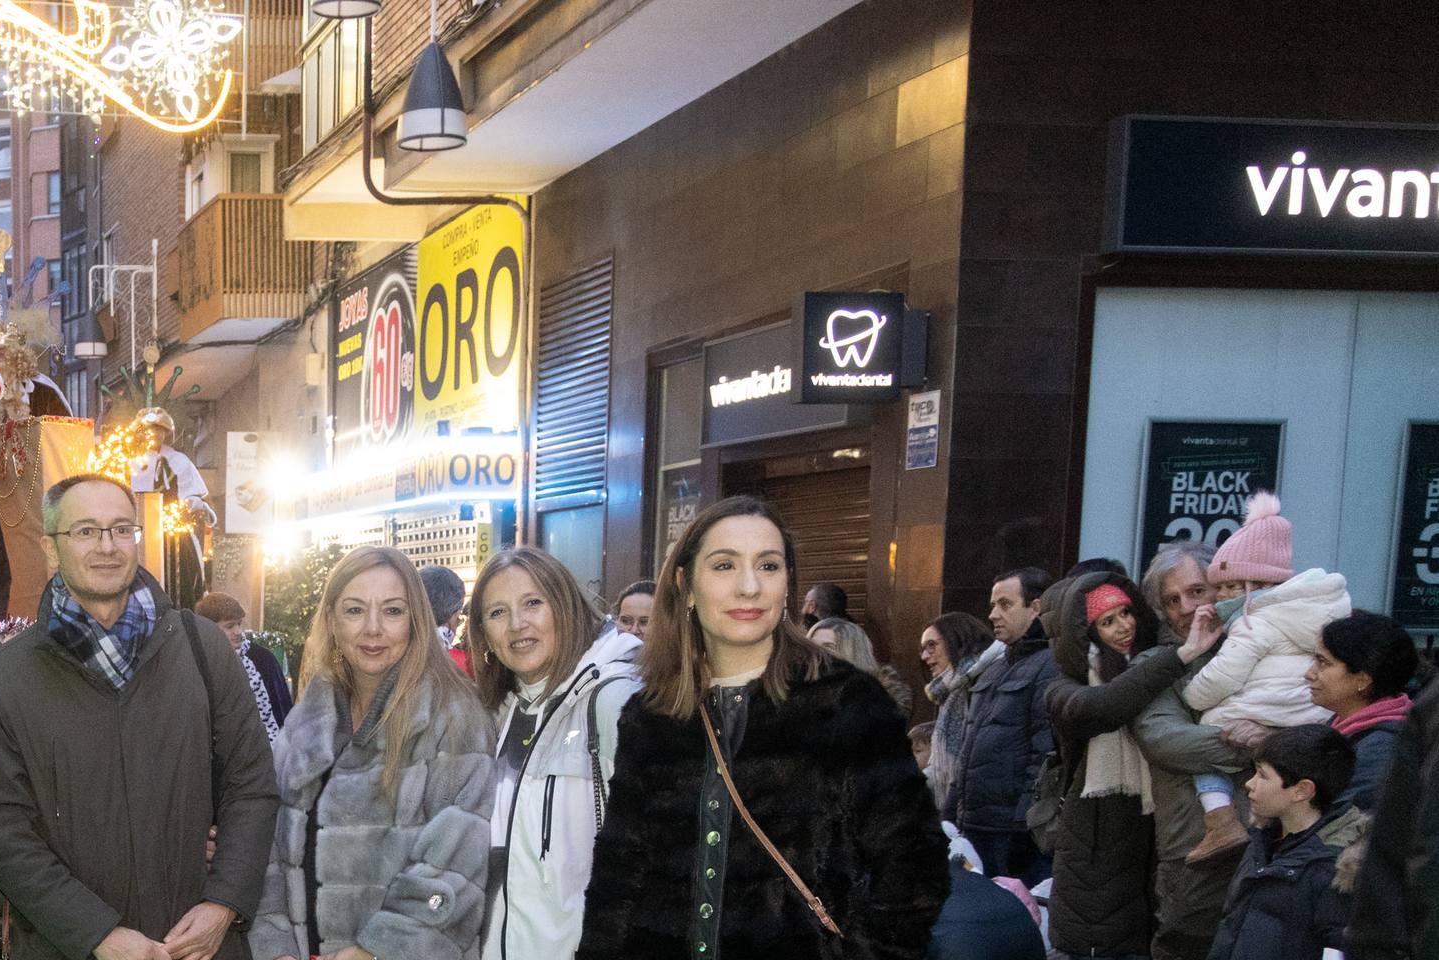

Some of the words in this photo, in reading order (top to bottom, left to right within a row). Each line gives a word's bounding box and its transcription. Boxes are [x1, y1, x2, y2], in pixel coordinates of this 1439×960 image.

[338, 286, 369, 333] JOYAS
[420, 246, 520, 401] ORO
[370, 300, 402, 443] 60
[448, 453, 515, 486] ORO
[1172, 471, 1251, 493] BLACK
[1169, 493, 1254, 515] FRIDAY
